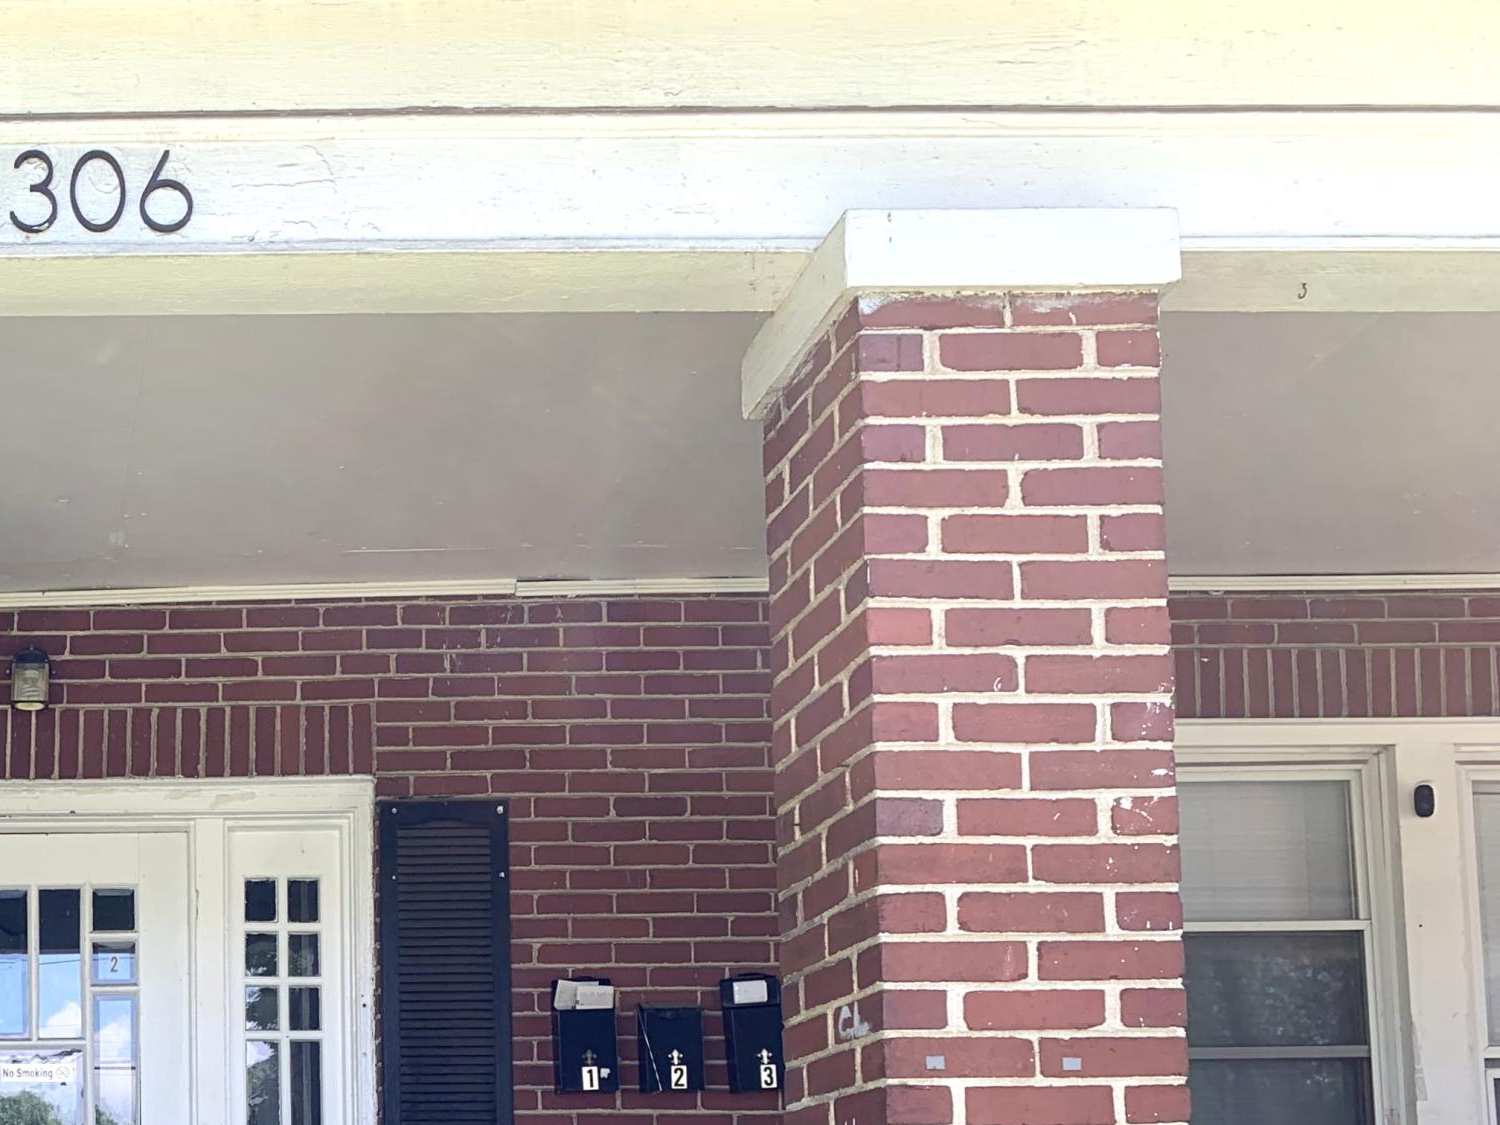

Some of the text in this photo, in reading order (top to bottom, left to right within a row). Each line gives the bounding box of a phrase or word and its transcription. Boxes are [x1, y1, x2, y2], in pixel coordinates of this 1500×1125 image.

[110, 956, 119, 973] 2
[2, 1068, 53, 1080] No Smoking
[586, 1069, 594, 1088] 1
[673, 1067, 685, 1087] 2
[763, 1066, 775, 1086] 3
